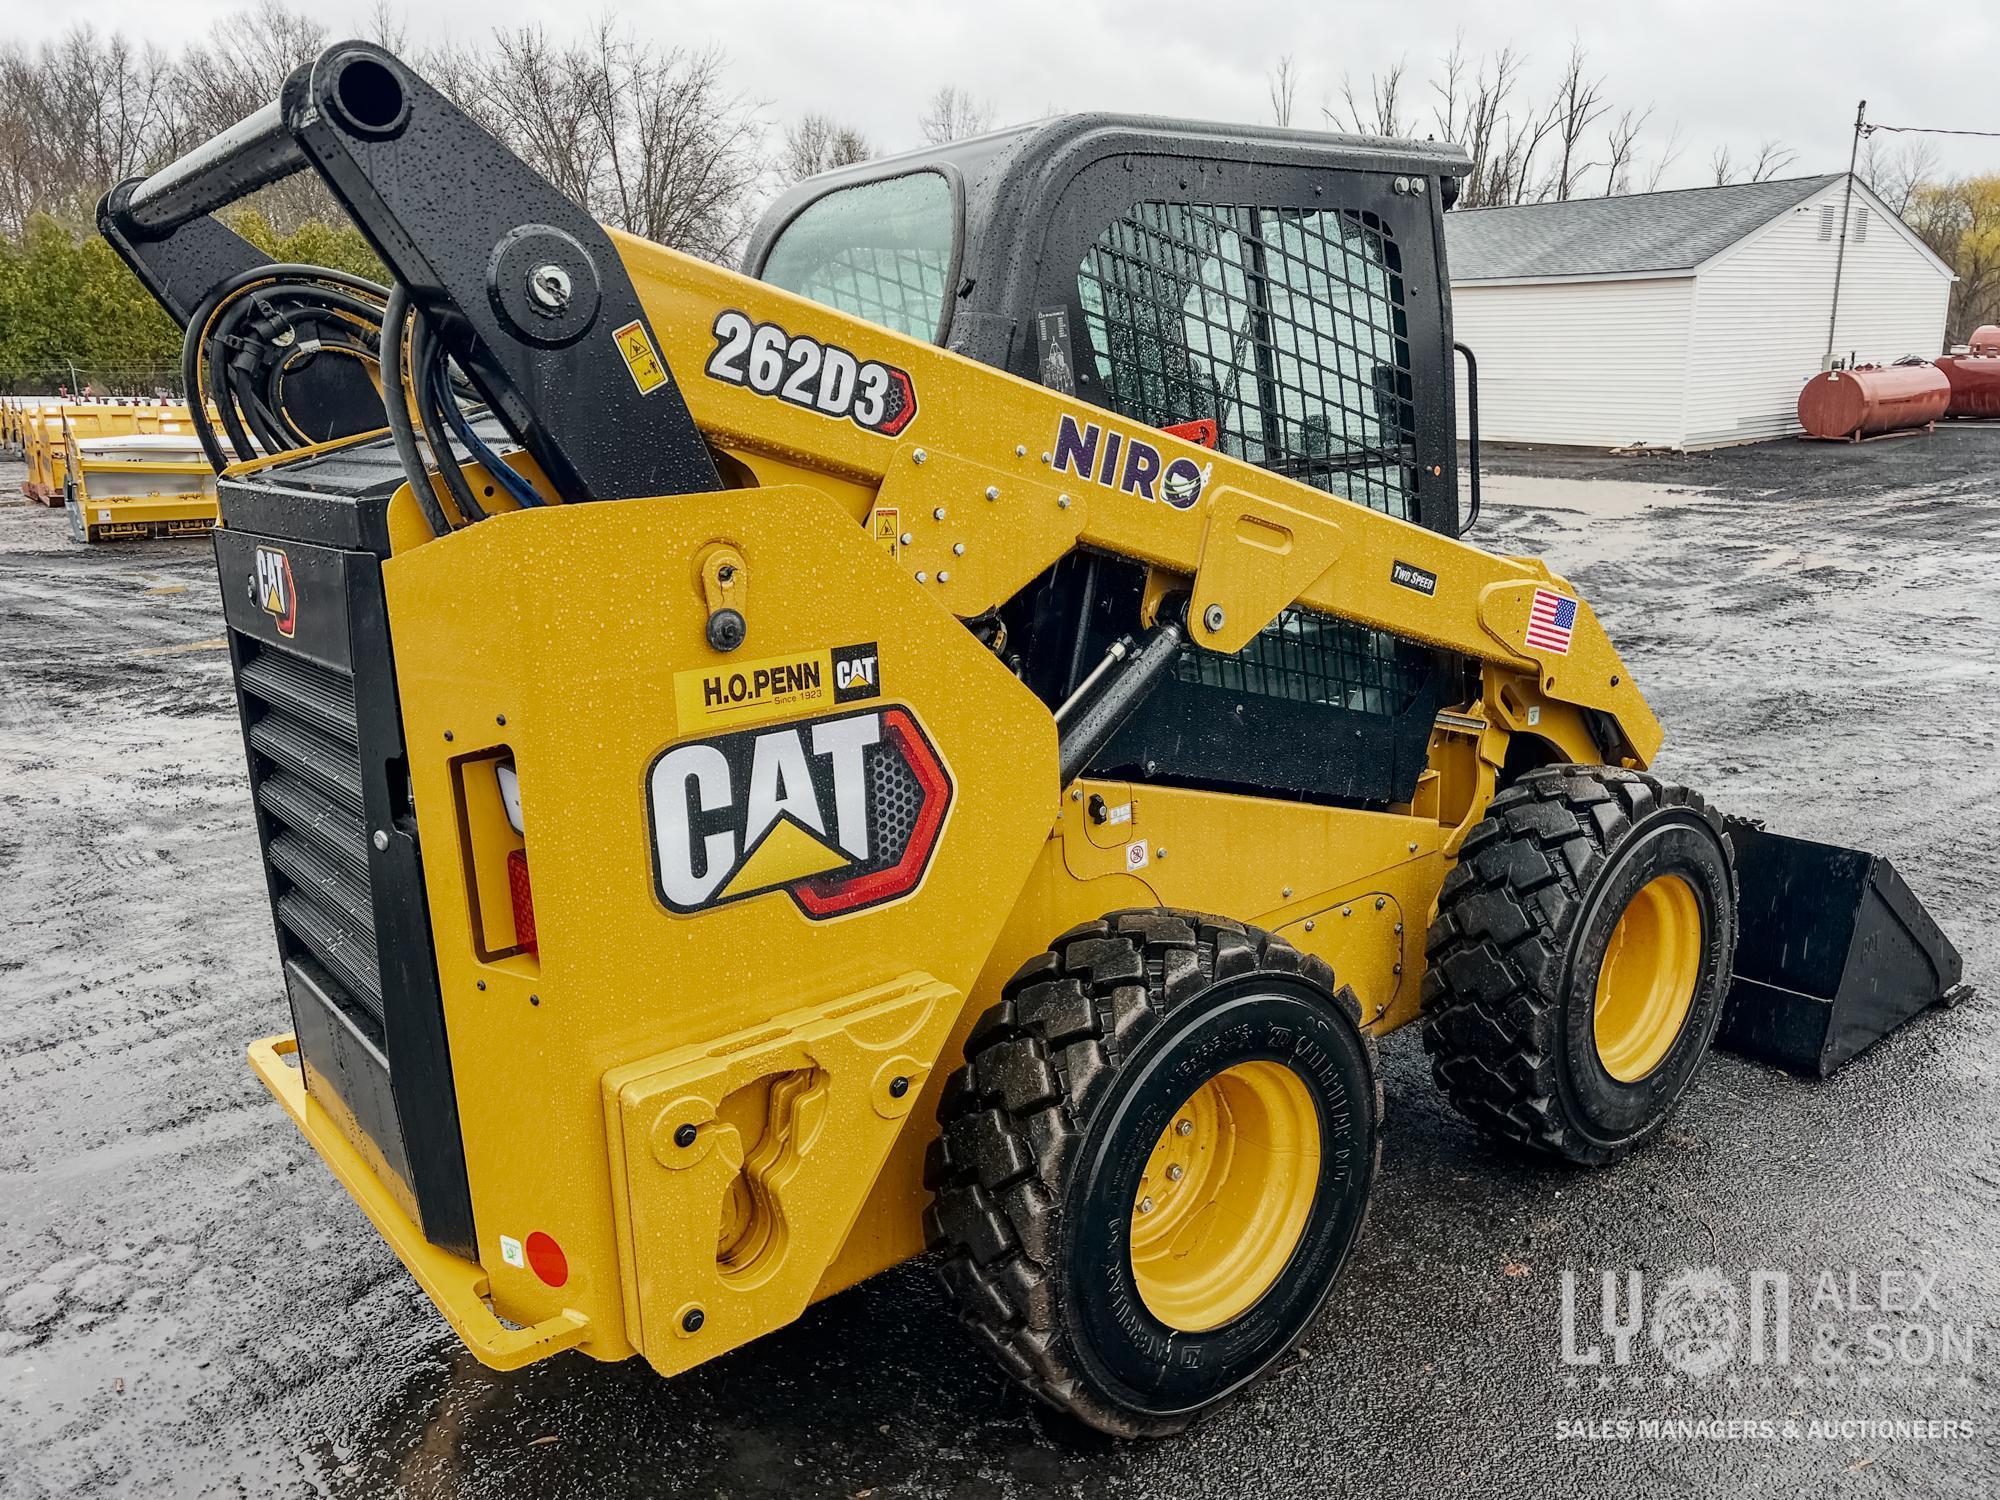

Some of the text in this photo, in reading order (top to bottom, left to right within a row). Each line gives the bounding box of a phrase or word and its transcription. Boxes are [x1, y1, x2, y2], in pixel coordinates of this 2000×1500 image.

[708, 312, 889, 426] 262D3
[1051, 413, 1204, 512] NIRO
[256, 549, 286, 614] CAT
[703, 656, 878, 707] H.O.PENN CAT
[774, 689, 823, 705] Since 1923
[651, 712, 881, 906] CAT
